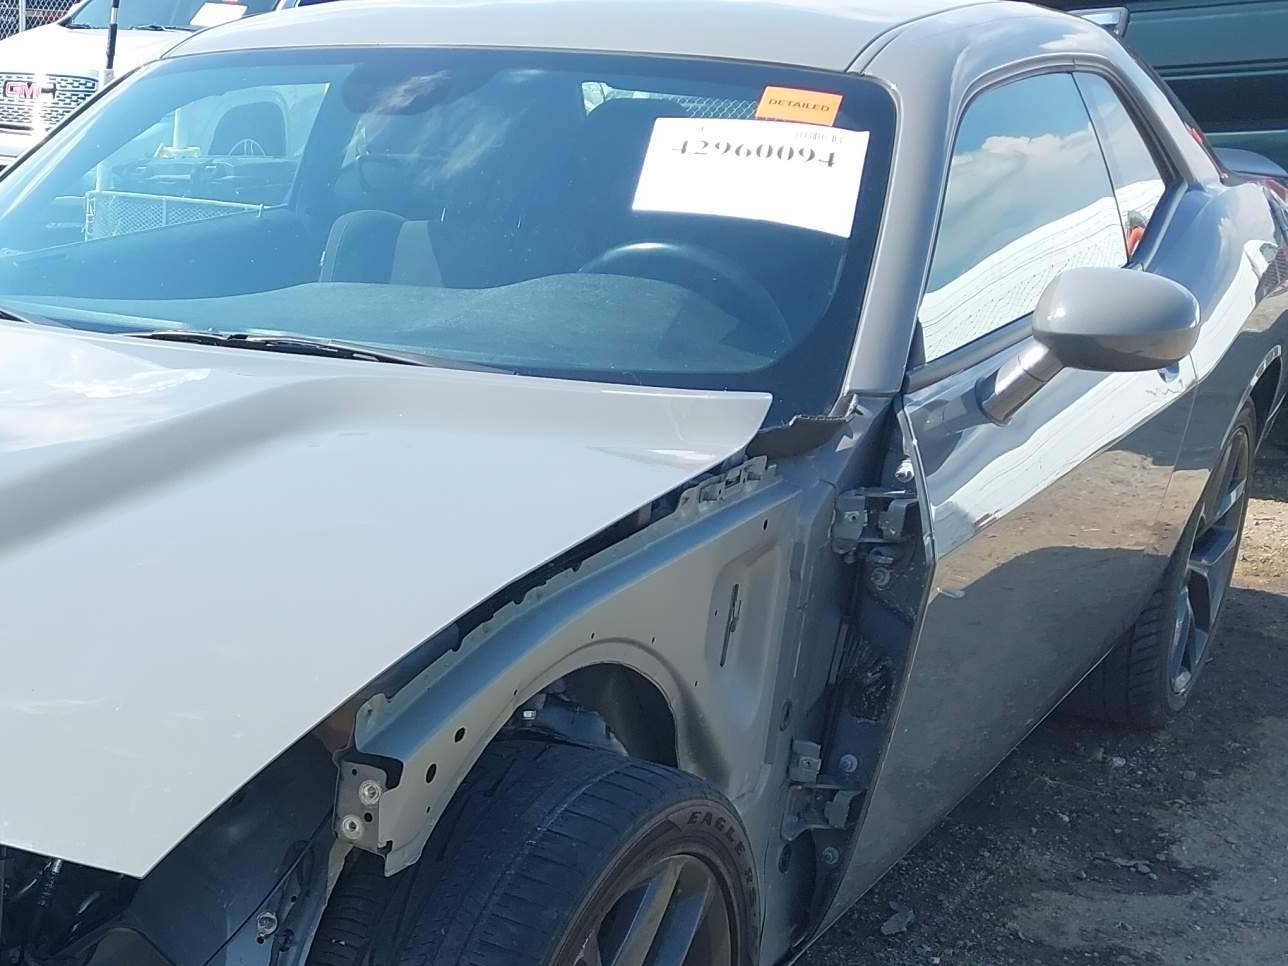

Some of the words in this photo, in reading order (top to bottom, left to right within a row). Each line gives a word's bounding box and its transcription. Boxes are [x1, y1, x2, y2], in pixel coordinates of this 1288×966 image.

[768, 98, 830, 112] DETAILED
[672, 140, 836, 167] 42960094
[687, 811, 746, 856] EAGLE
